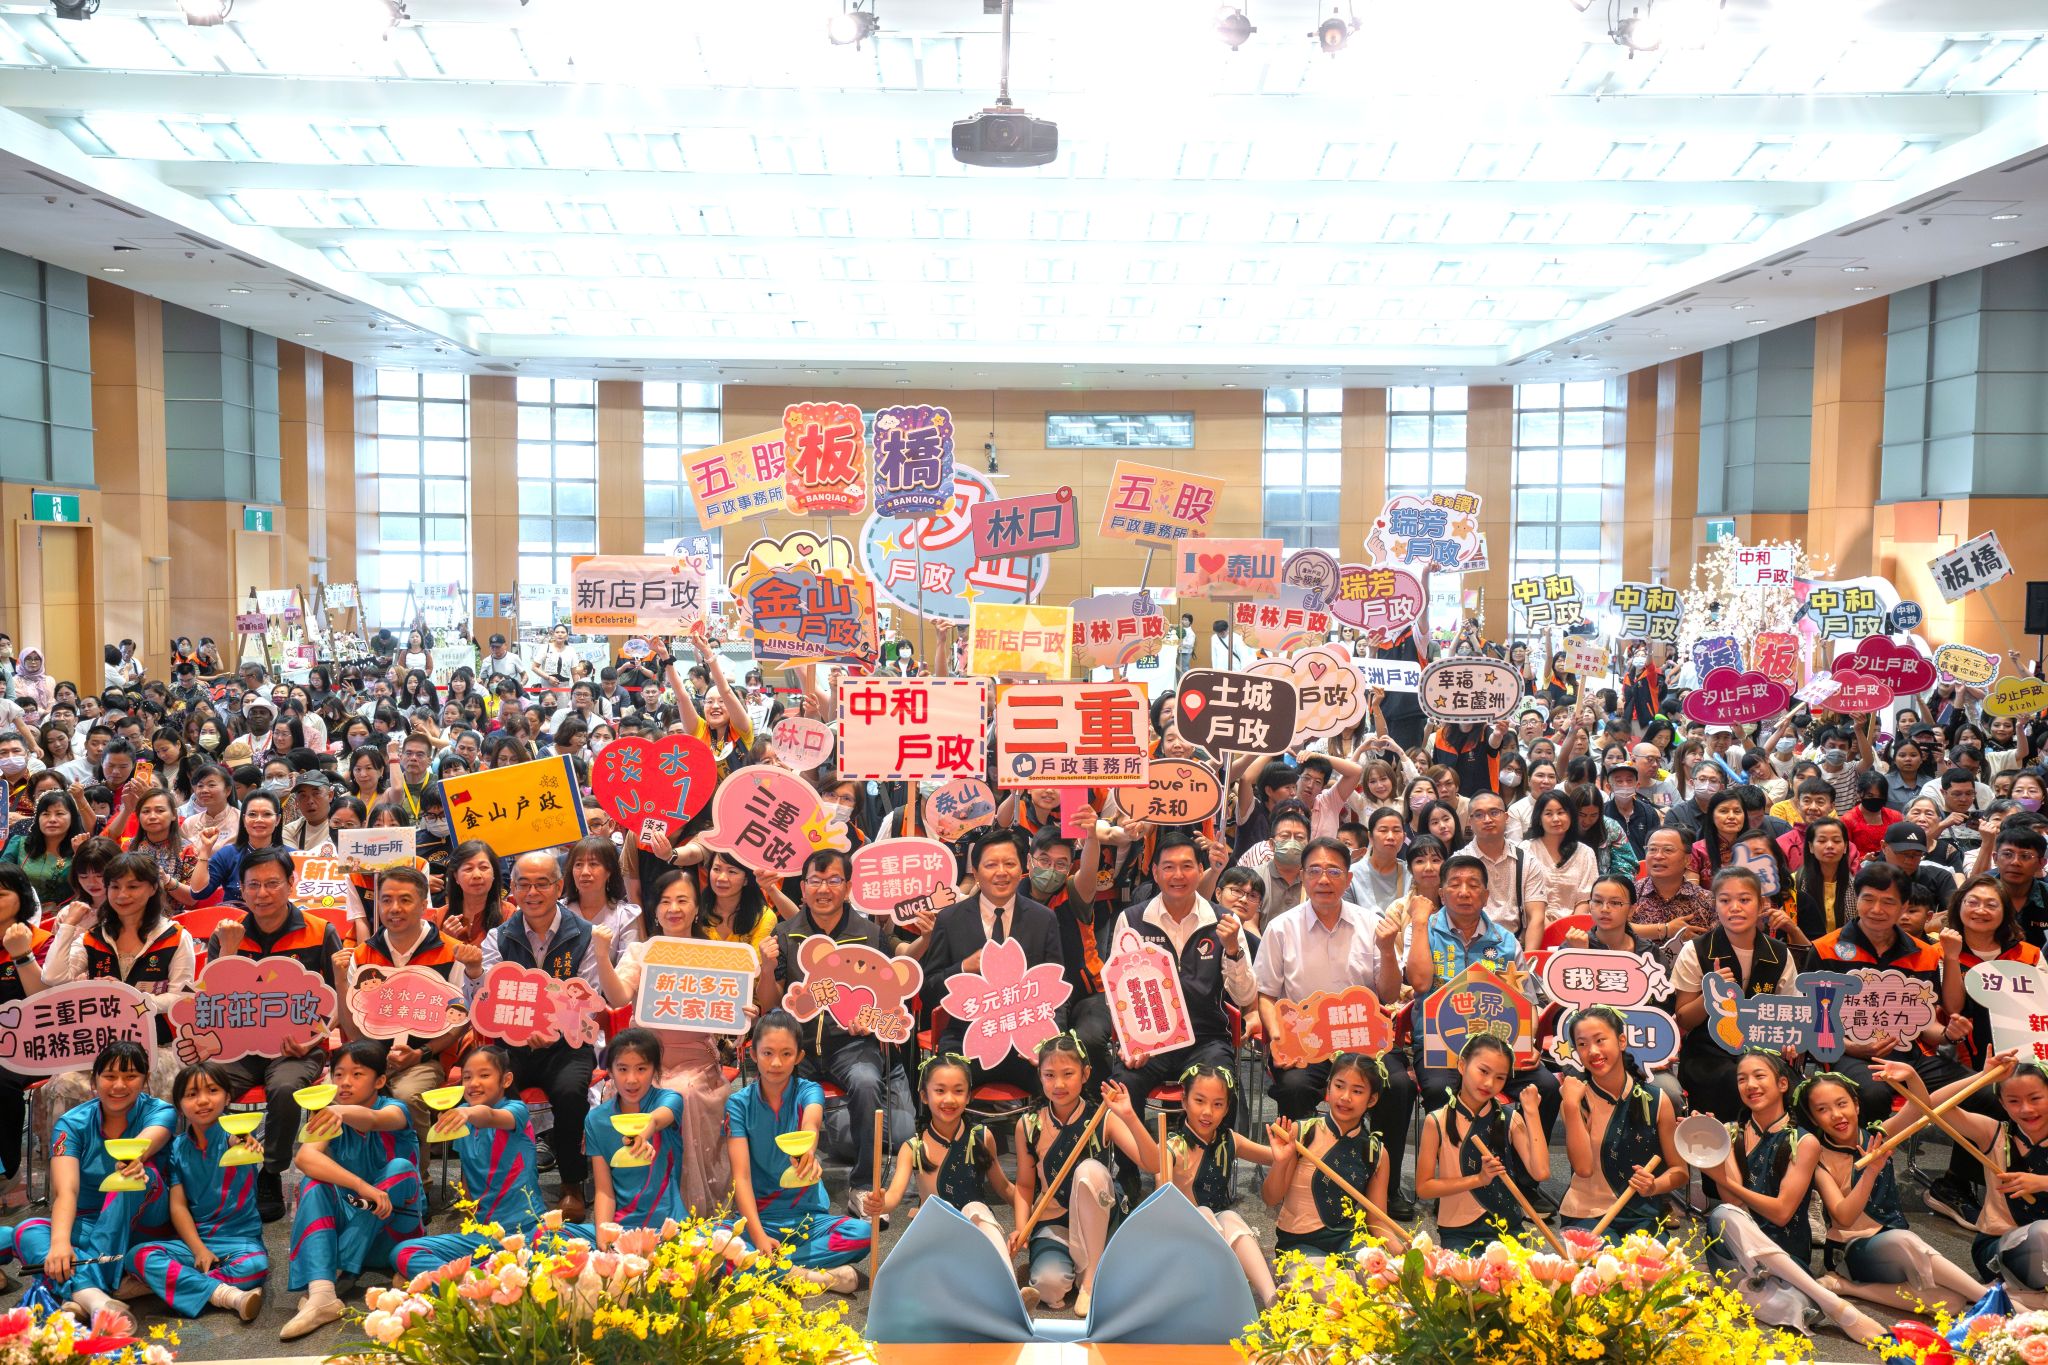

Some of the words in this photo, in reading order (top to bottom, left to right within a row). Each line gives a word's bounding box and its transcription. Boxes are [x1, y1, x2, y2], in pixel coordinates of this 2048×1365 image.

[793, 423, 858, 485] 板
[880, 425, 944, 491] 橋
[690, 441, 785, 500] 五股
[706, 486, 783, 519] 戶政事務所
[805, 493, 848, 504] BANQIAO
[892, 495, 936, 506] BANQIAO
[1114, 473, 1215, 525] 五股
[986, 505, 1064, 548] 林口
[1110, 515, 1188, 539] 戶政事務所
[1390, 507, 1448, 538] 瑞芳
[1184, 553, 1198, 573] I
[1227, 554, 1275, 579] 泰山
[1404, 538, 1461, 567] 戶政
[1740, 551, 1771, 566] 中和
[886, 559, 954, 594] 戶政
[1756, 568, 1789, 584] 戶政
[1942, 544, 2004, 592] 板橋
[577, 580, 700, 609] 新店戶政
[751, 577, 852, 619] 金山
[1341, 570, 1395, 601] 瑞芳
[1512, 573, 1576, 605] 中和
[1613, 585, 1677, 613] 中和
[1362, 597, 1418, 626] 戶政
[1810, 587, 1876, 616] 中和
[1897, 605, 1916, 613] 中和
[574, 614, 594, 624] Let's
[596, 614, 635, 624] Celebrate!
[1236, 603, 1328, 633] 樹林戶政
[1526, 603, 1585, 630] 戶政
[1621, 613, 1680, 642] 戶政
[1822, 615, 1883, 640] 戶政
[1898, 616, 1917, 625] 戶政
[797, 615, 861, 647] 戶政
[975, 627, 1067, 654] 新店戶政
[765, 638, 825, 653] JINSHAN
[1758, 643, 1795, 679] 板
[1852, 654, 1920, 674] 汐止戶政
[1439, 670, 1474, 690] 幸福
[850, 687, 928, 726] 中和
[1209, 677, 1273, 712] 土城
[1299, 683, 1348, 710] 戶政
[1452, 691, 1506, 711] 在蘆洲
[1702, 683, 1769, 706] 汐止戶政
[1840, 699, 1868, 708] Xizhi
[1995, 685, 2044, 704] 汐止戶政
[2009, 699, 2037, 712] Xizhi
[1005, 688, 1141, 755] 三重
[1717, 703, 1756, 719] Xizhi
[775, 723, 824, 751] 林口
[1206, 715, 1270, 749] 戶政
[606, 744, 689, 784] 淡水
[895, 734, 975, 772] 戶政
[1041, 757, 1142, 775] 戶政事務所
[936, 783, 980, 815] 泰山
[1139, 779, 1184, 792] ove
[1190, 779, 1208, 793] in
[461, 791, 563, 831] 金山戶政
[744, 785, 800, 835] 三重
[1148, 799, 1188, 817] 永和
[645, 819, 665, 832] 淡水
[351, 840, 403, 857] 土城戶所
[734, 820, 797, 869] 戶政
[859, 852, 944, 878] 三重戶政
[897, 896, 933, 920] NICE!
[497, 979, 538, 1003] 我愛
[655, 973, 739, 997] 新北多元
[1563, 967, 1629, 992] 我愛
[1981, 973, 2035, 995] 汐止
[195, 990, 321, 1029] 新莊戶政
[380, 987, 444, 1008] 淡水戶政
[653, 996, 735, 1024] 大家庭
[810, 977, 840, 1007] 熊
[858, 1004, 902, 1040] 新北
[962, 980, 1041, 1022] 多元新力
[1127, 977, 1151, 1032] 新北新力
[1451, 991, 1504, 1017] 世界
[1844, 991, 1918, 1009] 板橋戶所
[34, 994, 121, 1029] 三重戶政
[493, 1003, 536, 1028] 新北
[981, 1002, 1055, 1039] 幸福未來
[1328, 1004, 1369, 1025] 新北
[1740, 1002, 1812, 1023] 一起展現
[1853, 1010, 1909, 1028] 最給力
[1331, 1026, 1371, 1048] 愛我
[1748, 1024, 1802, 1045] 新活力
